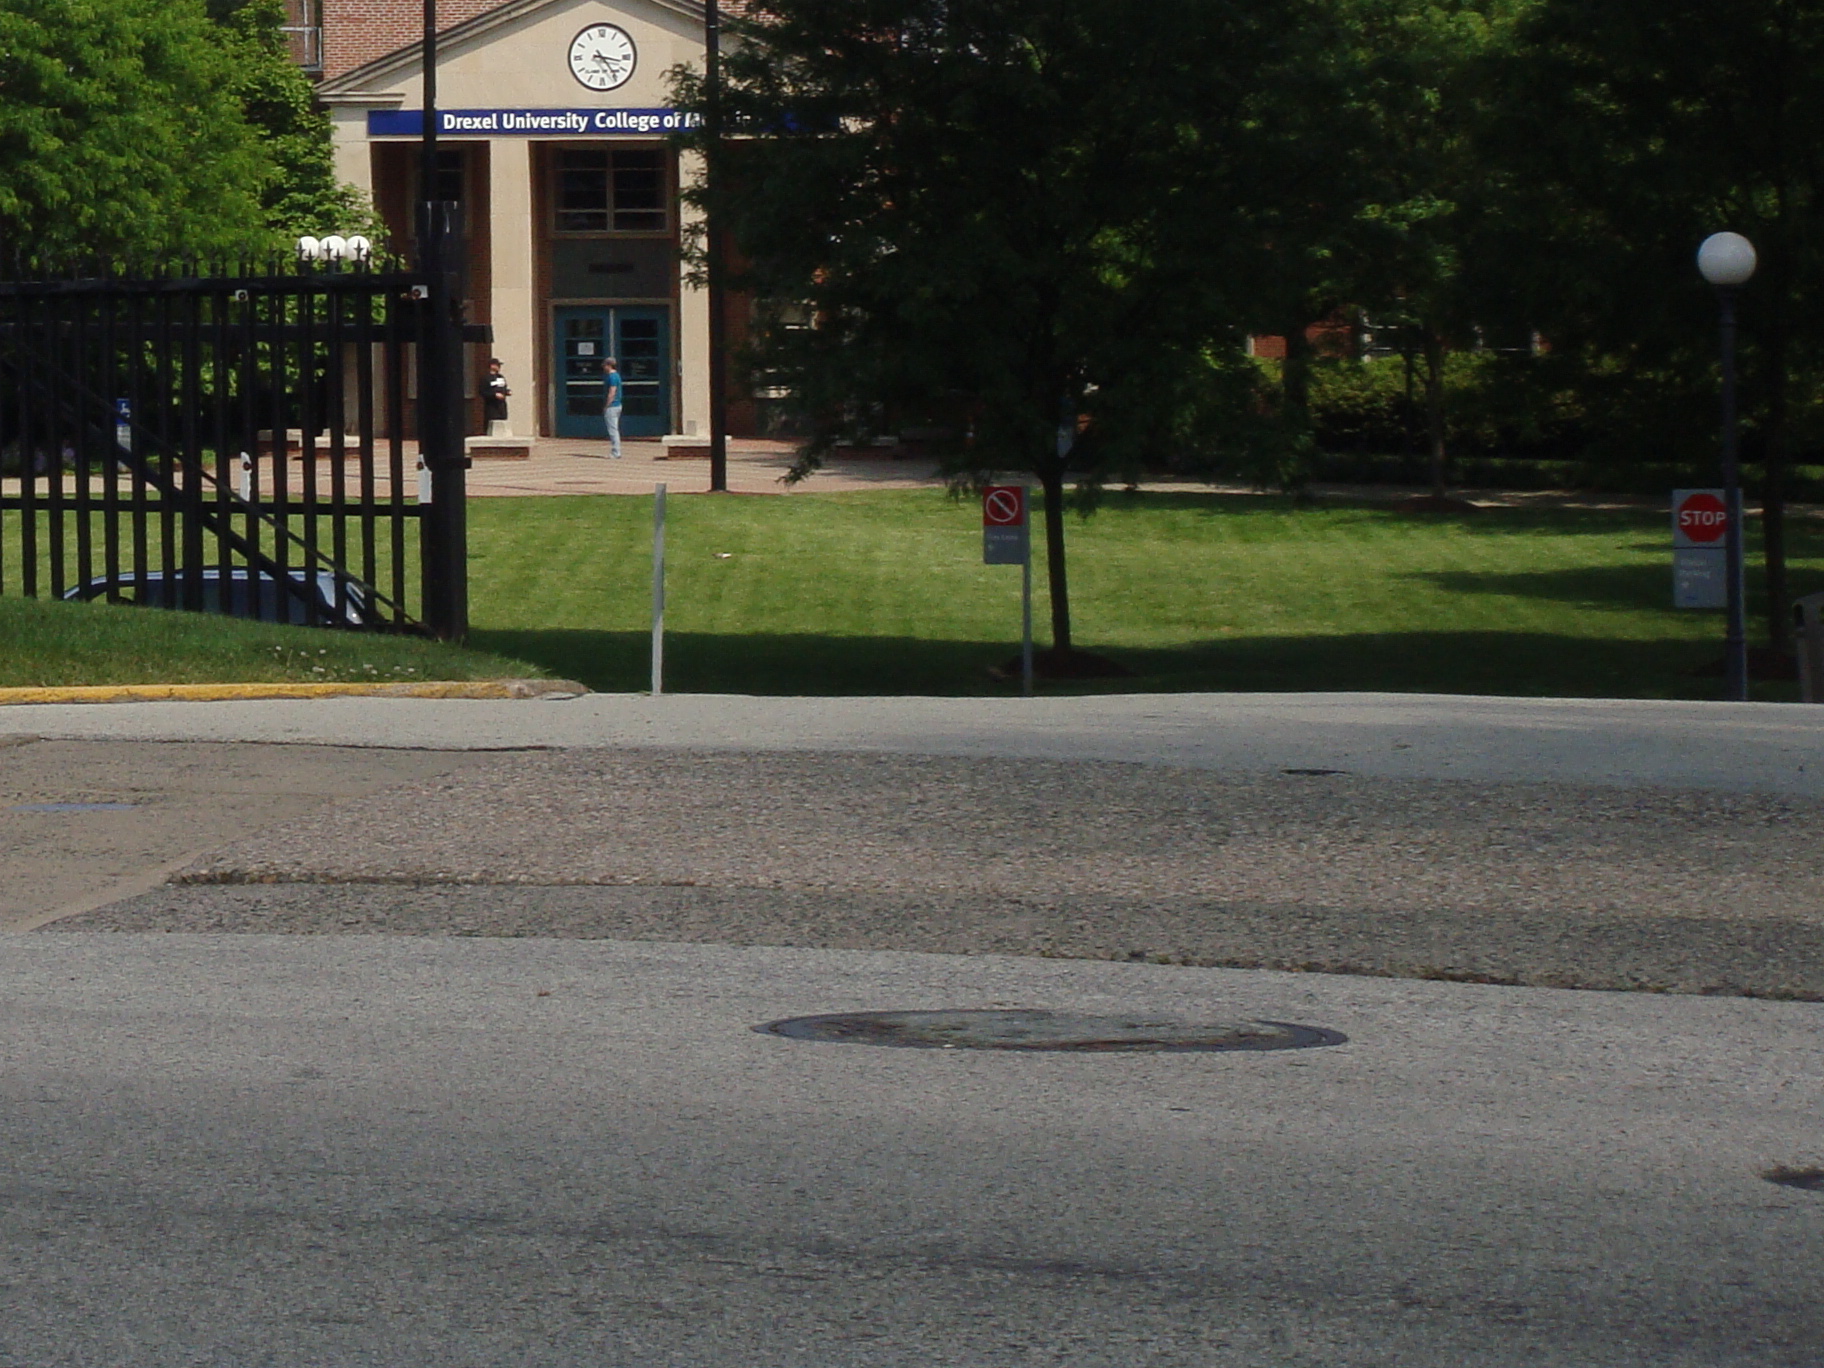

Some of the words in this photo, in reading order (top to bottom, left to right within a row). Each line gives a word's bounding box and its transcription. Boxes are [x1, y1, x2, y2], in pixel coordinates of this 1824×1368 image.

[443, 114, 498, 130] Drexel
[502, 112, 588, 132] University
[594, 111, 660, 132] College
[663, 112, 682, 128] of
[1680, 510, 1727, 526] STOP
